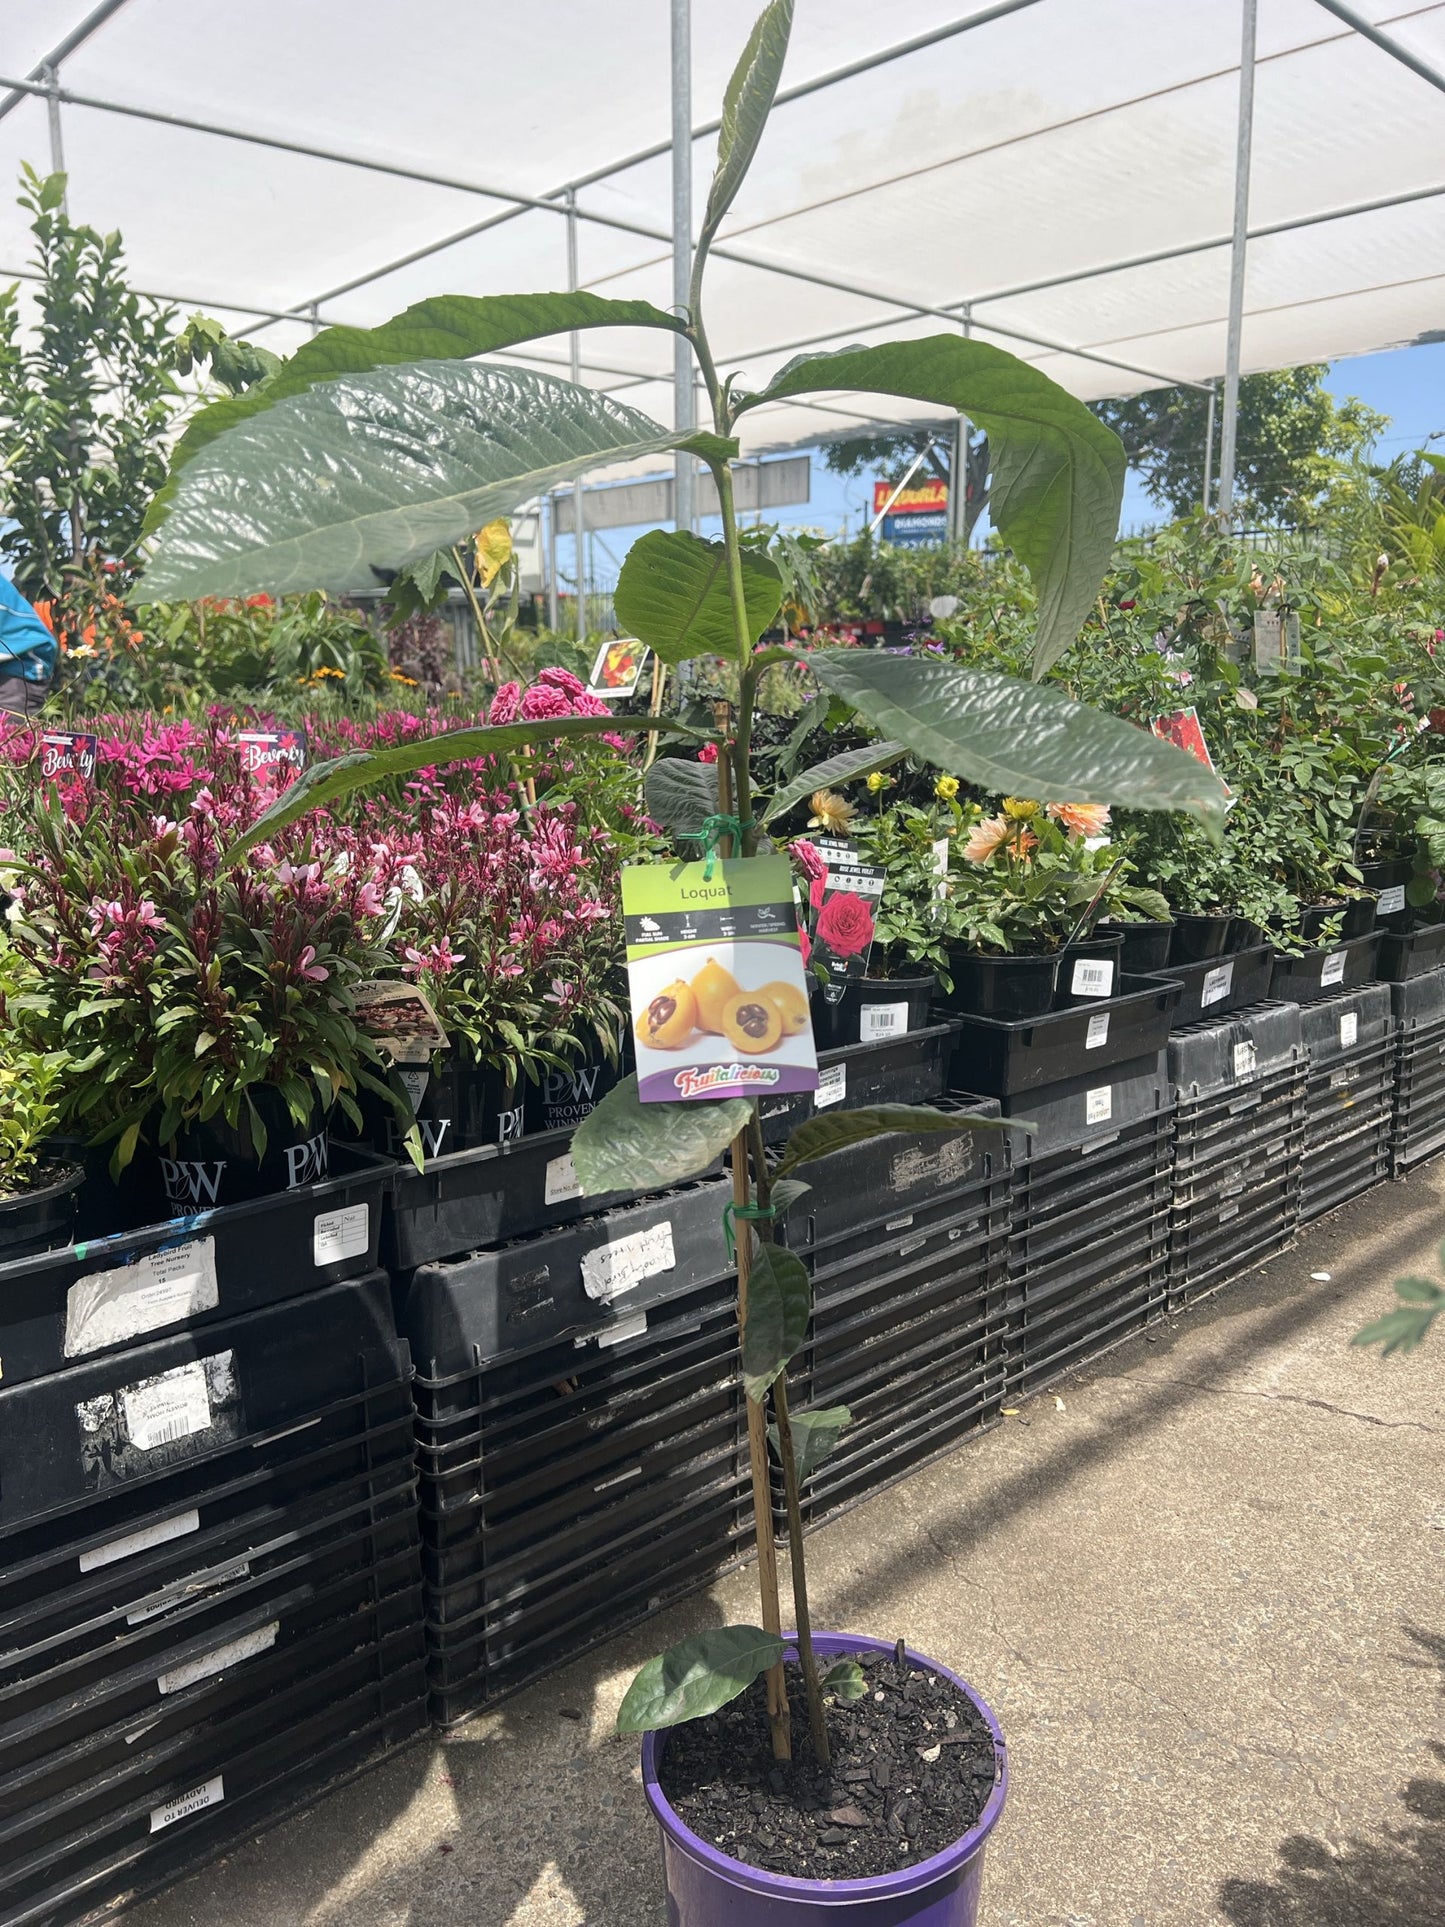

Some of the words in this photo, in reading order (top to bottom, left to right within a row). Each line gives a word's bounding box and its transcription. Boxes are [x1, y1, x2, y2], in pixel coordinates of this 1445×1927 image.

[681, 884, 733, 902] Loquat
[674, 1064, 780, 1098] Fruitalicious
[158, 1157, 229, 1203] PW
[165, 1253, 191, 1263] Nursery
[167, 1264, 185, 1273] Packs
[165, 1785, 206, 1810] LADYBIRD
[177, 1795, 210, 1815] DELIVER
[163, 1812, 176, 1822] TO
